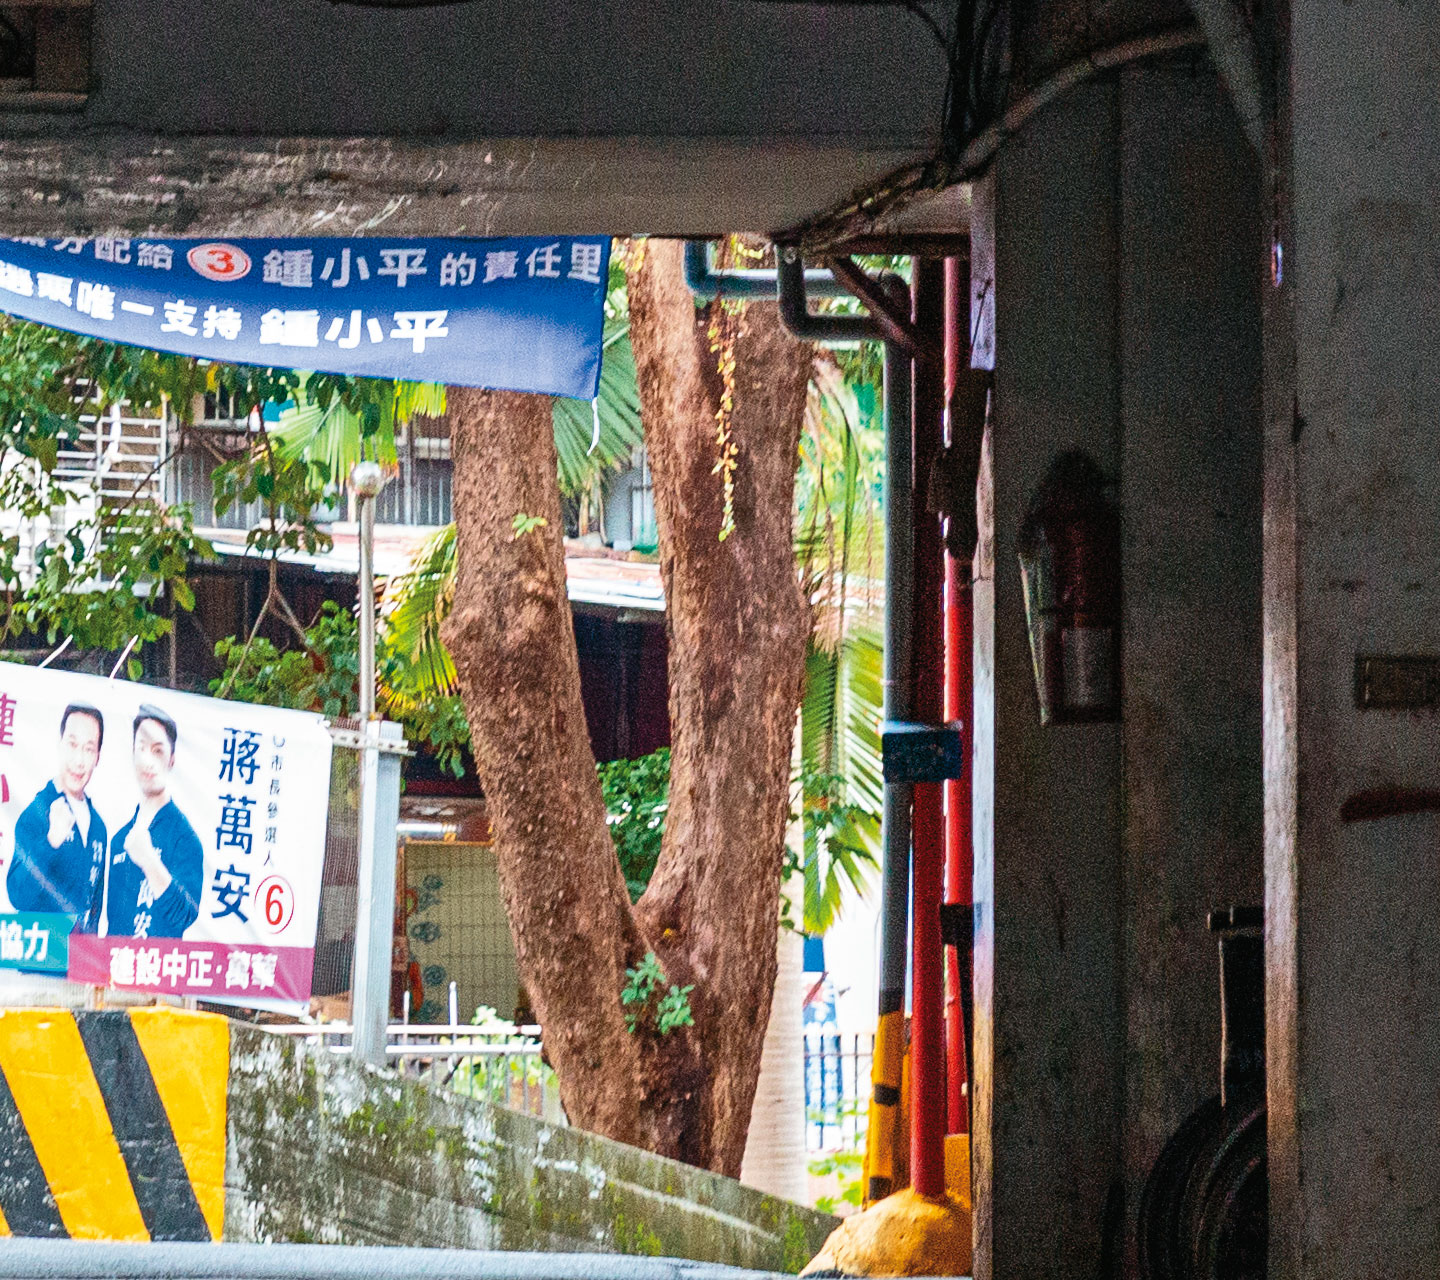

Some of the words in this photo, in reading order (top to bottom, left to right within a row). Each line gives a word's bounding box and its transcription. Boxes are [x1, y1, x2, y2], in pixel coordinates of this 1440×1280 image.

[263, 248, 428, 289] 鍾小平
[440, 243, 602, 286] 的責任里
[260, 309, 450, 354] 鍾小平
[211, 727, 263, 924] 蔣萬安
